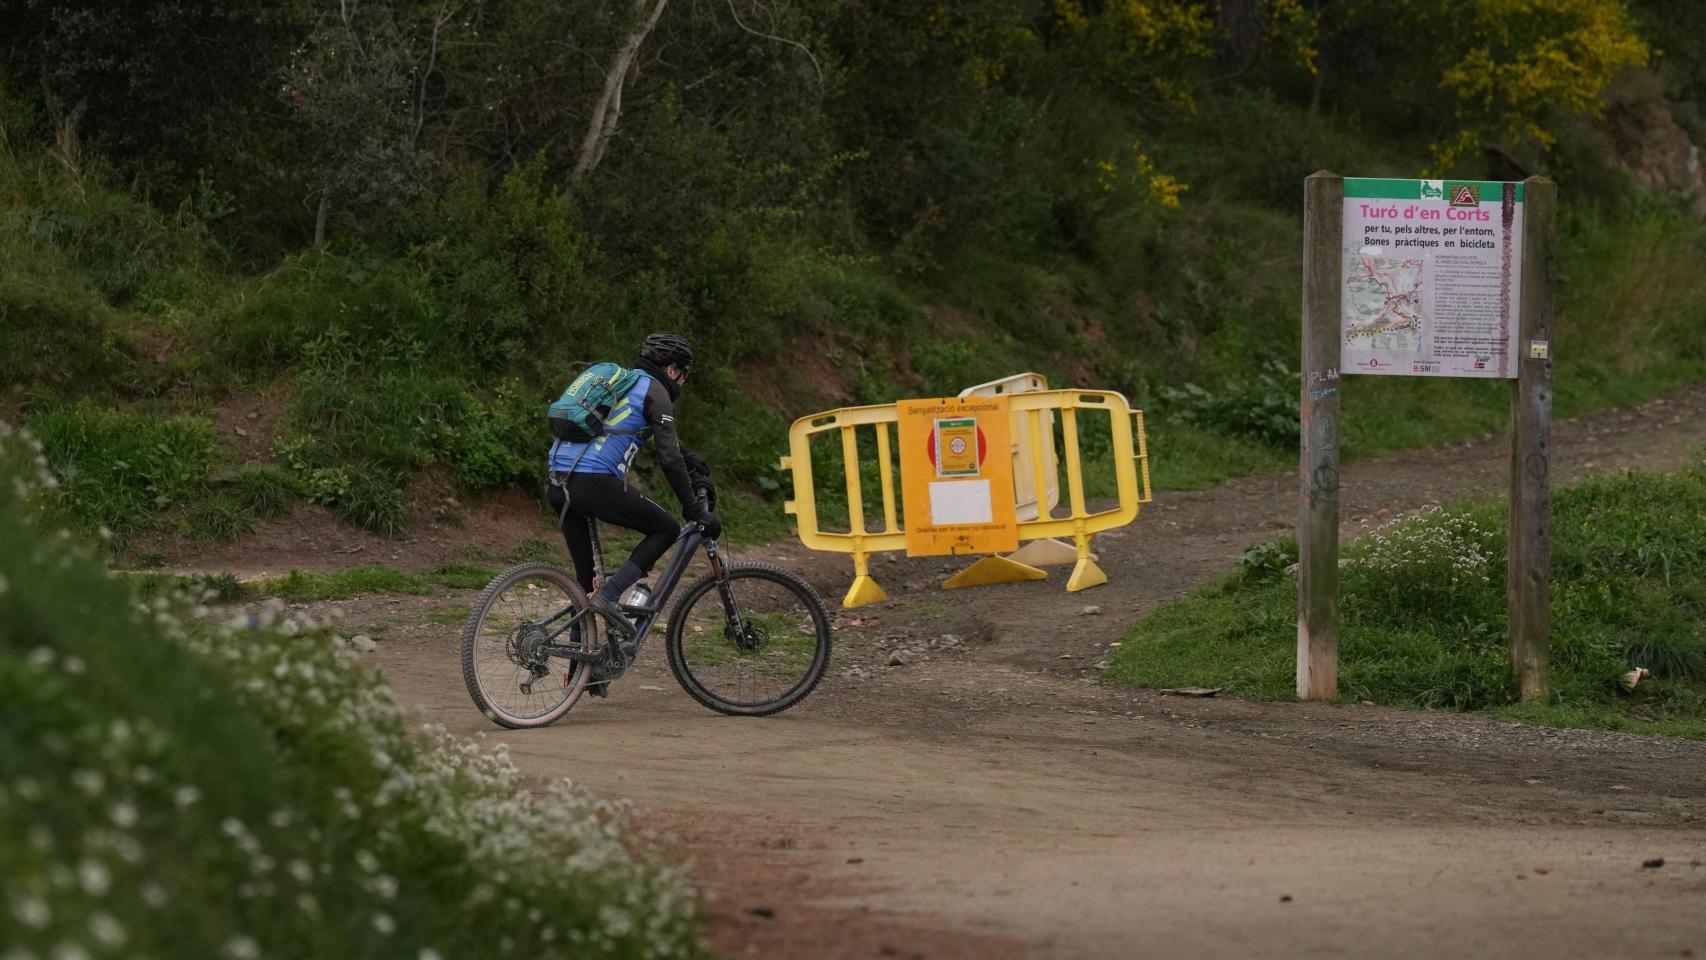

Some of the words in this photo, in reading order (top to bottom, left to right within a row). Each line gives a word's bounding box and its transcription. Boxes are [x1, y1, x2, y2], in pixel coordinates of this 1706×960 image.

[1360, 204, 1398, 219] Turó
[1403, 205, 1440, 220] d'en
[1446, 207, 1490, 221] Corts
[1364, 226, 1378, 235] per
[1381, 226, 1392, 234] tu,
[1395, 225, 1412, 235] pels
[1414, 226, 1441, 236] altres,
[1443, 228, 1457, 237] per
[1459, 226, 1495, 237] l'entorn,
[1364, 236, 1390, 246] Bones
[1395, 237, 1439, 249] pràctiques
[1444, 240, 1455, 248] en
[1460, 239, 1495, 249] bicicleta
[957, 402, 999, 413] excepcional
